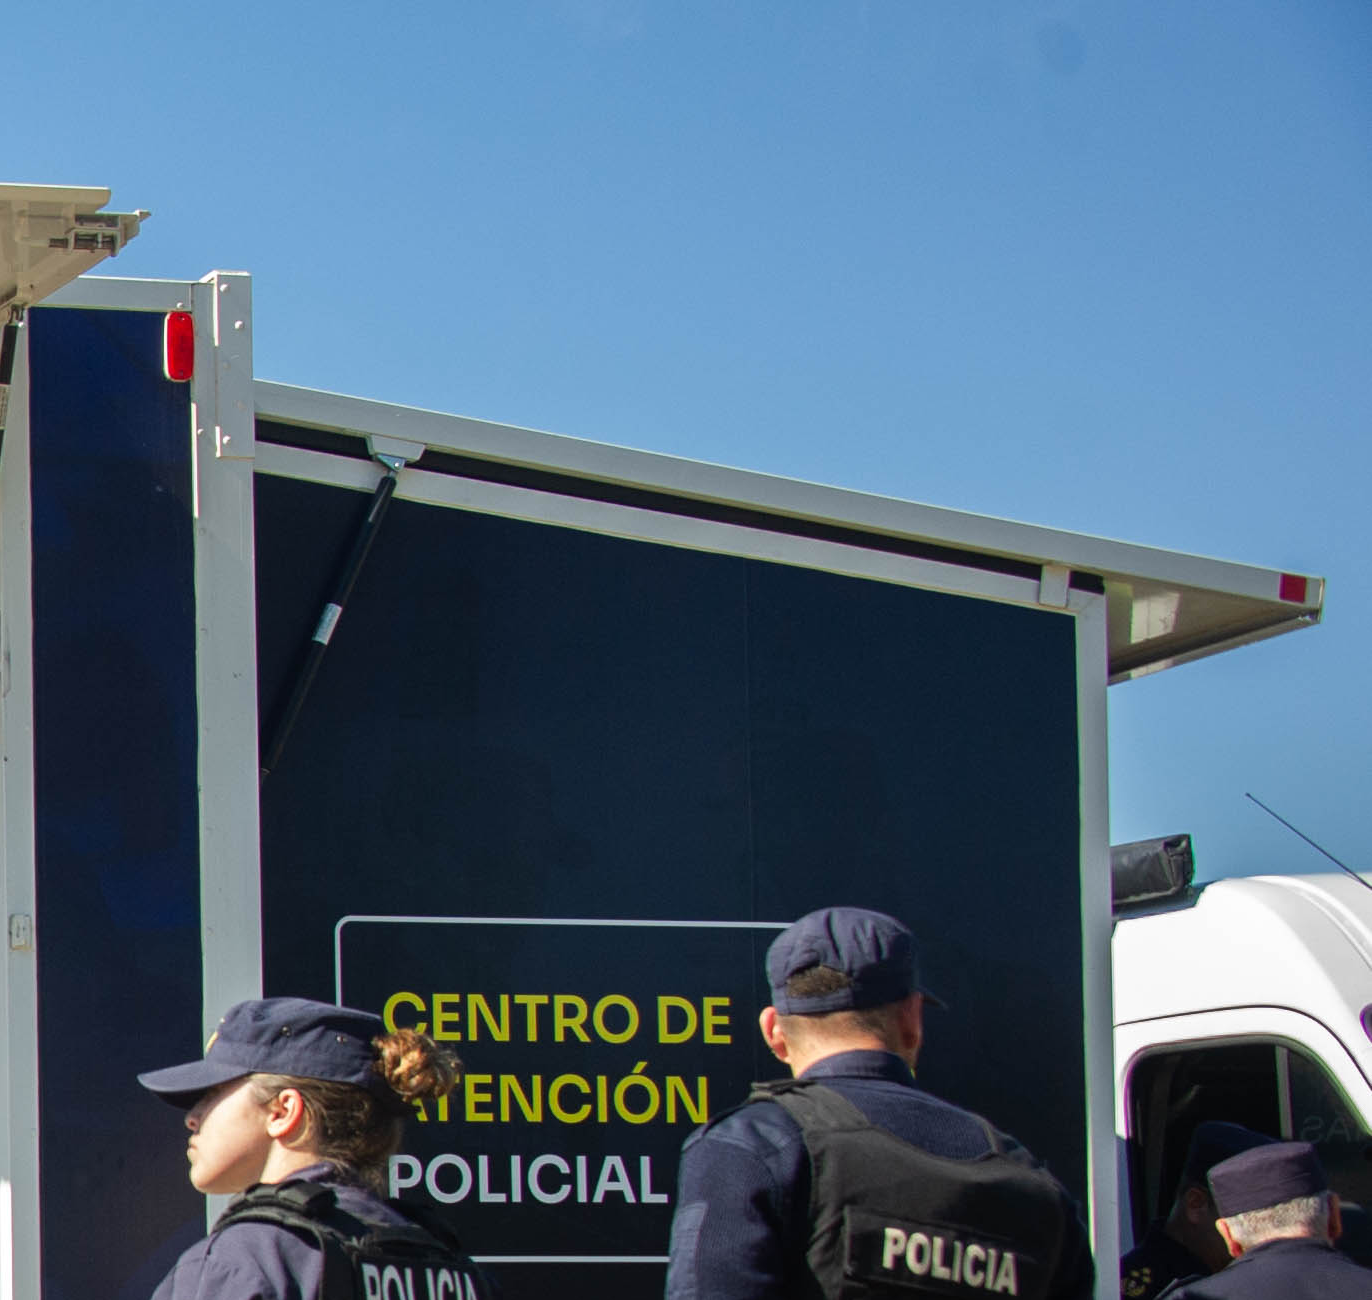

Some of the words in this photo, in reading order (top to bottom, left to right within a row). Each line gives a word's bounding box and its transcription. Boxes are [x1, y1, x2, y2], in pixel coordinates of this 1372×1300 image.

[383, 991, 640, 1044] CENTRO
[658, 996, 732, 1044] DE
[411, 1061, 709, 1125] ENCIÓN
[388, 1154, 669, 1204] POLICIAL
[882, 1227, 1018, 1296] POLICIA
